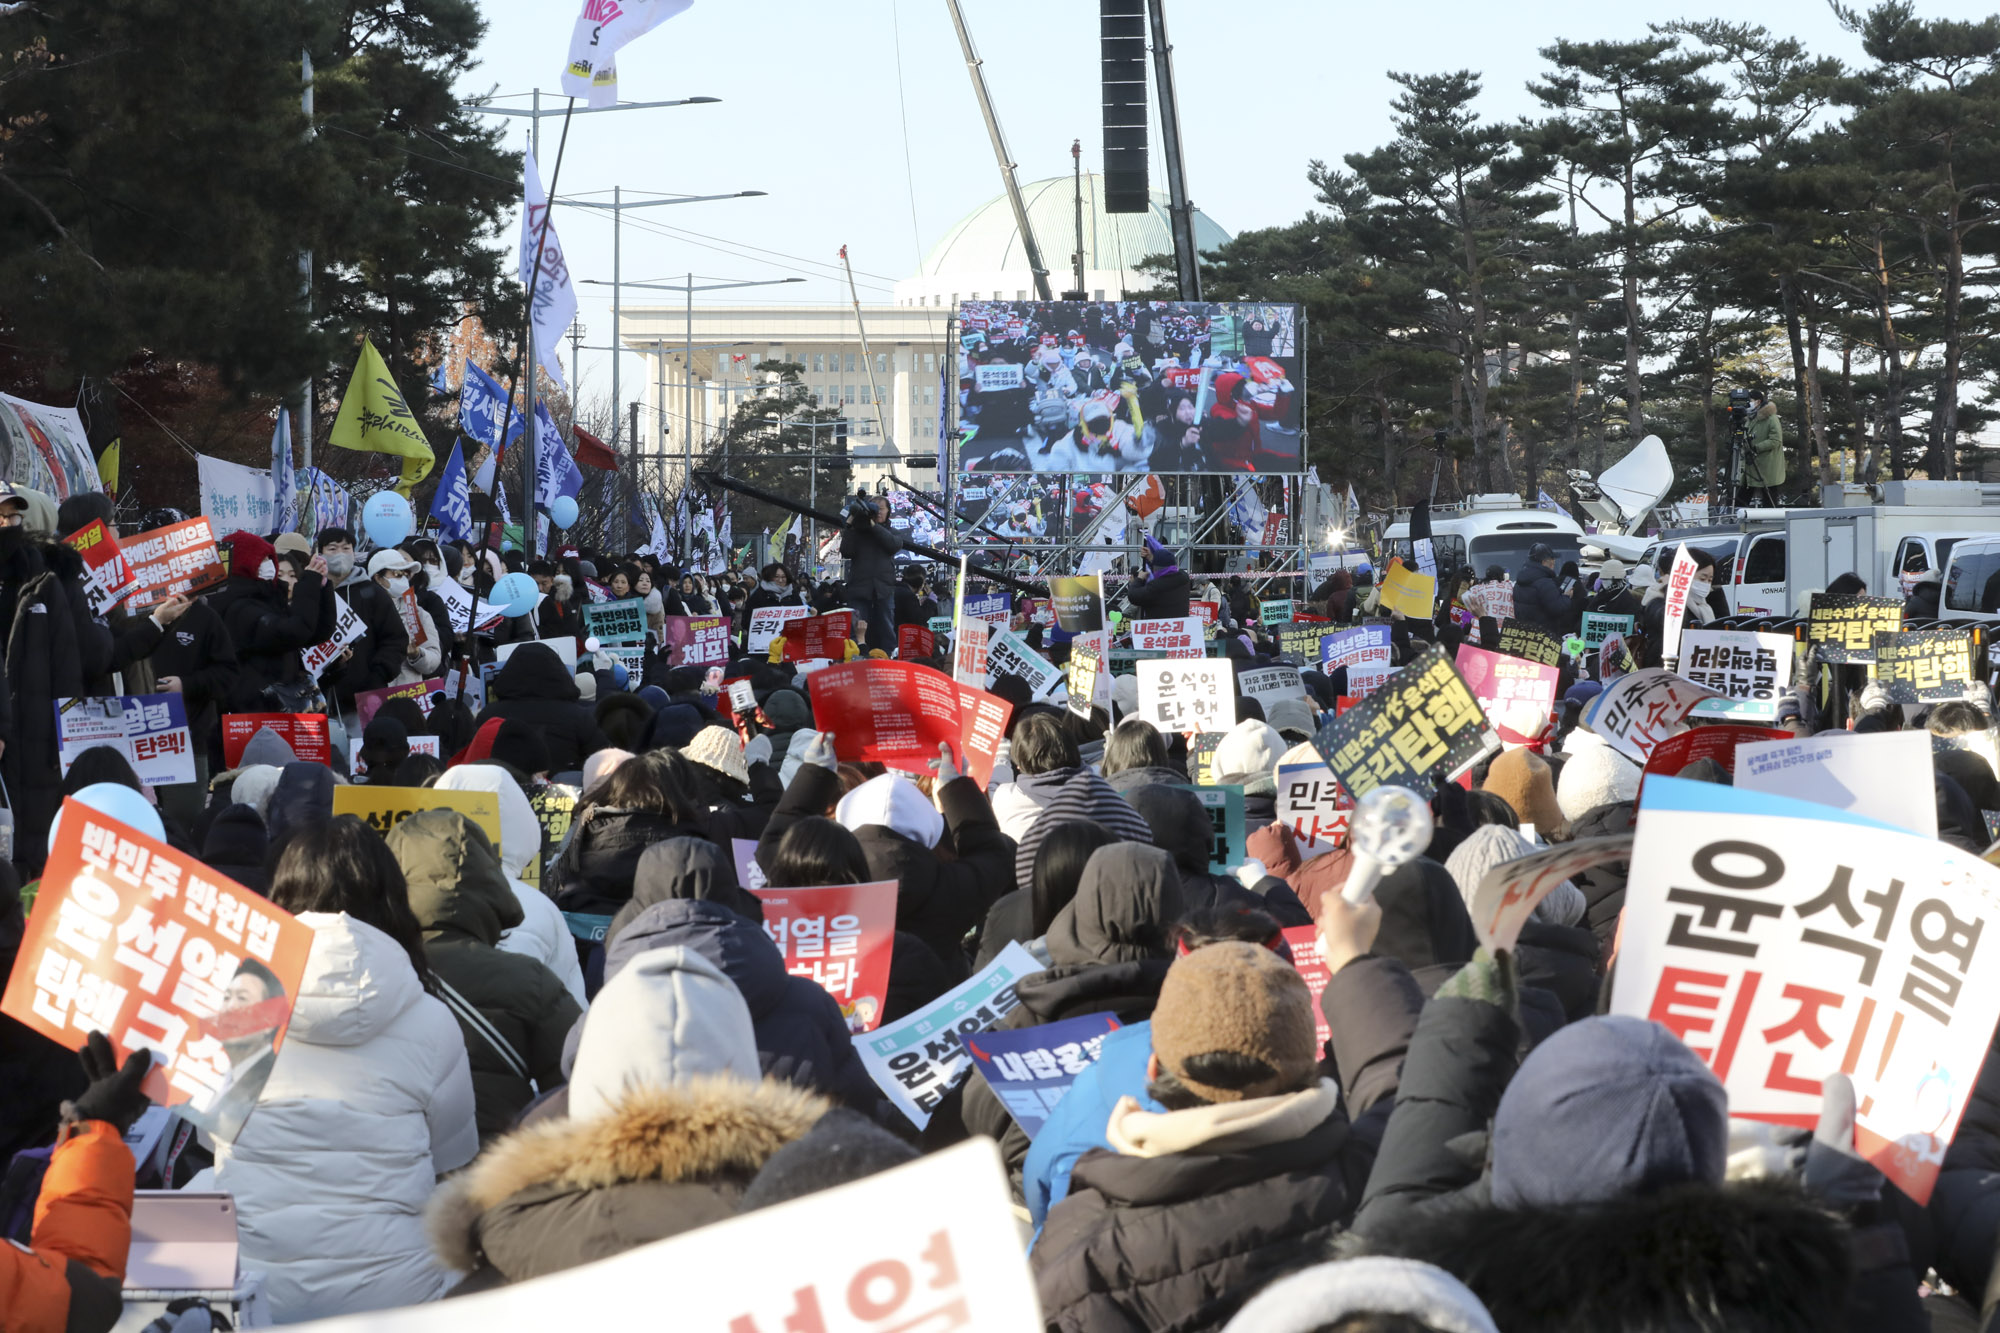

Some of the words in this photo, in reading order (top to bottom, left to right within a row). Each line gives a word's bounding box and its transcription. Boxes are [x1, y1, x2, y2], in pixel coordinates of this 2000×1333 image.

[1665, 559, 1696, 618] 국힘해산
[590, 606, 640, 623] 국민의힘
[753, 608, 782, 620] 내란수괴
[783, 608, 806, 618] 윤석열
[1587, 620, 1628, 632] 국민의힘
[1812, 608, 1855, 620] 내란수괴
[1866, 606, 1901, 620] 윤석열
[592, 620, 642, 637] 해산하라
[694, 625, 728, 643] 윤석열
[1134, 620, 1184, 635] 내란수괴
[1280, 630, 1308, 640] 내란수괴
[682, 638, 729, 665] 체포!
[1144, 634, 1192, 649] 윤석열을
[1328, 629, 1383, 658] 청년명령
[1878, 646, 1920, 660] 내란수괴
[1934, 638, 1968, 655] 윤석열
[1690, 646, 1777, 672] 탄핵하라
[1157, 670, 1217, 698] 윤석열
[1350, 676, 1374, 688] 내란범
[1157, 701, 1219, 730] 탄핵
[1330, 716, 1393, 776] 내란수괴
[1402, 658, 1456, 710] 윤석열
[134, 732, 186, 762] 탄핵!
[1783, 754, 1815, 768] 민주주의
[80, 820, 182, 902] 반민주
[184, 874, 281, 963] 반헌법
[55, 862, 241, 1021] 윤석열
[1666, 838, 1986, 1027] 윤석열
[32, 948, 128, 1036] 탄핵
[1647, 965, 1905, 1117] 퇴진!
[122, 1001, 233, 1115] 구속
